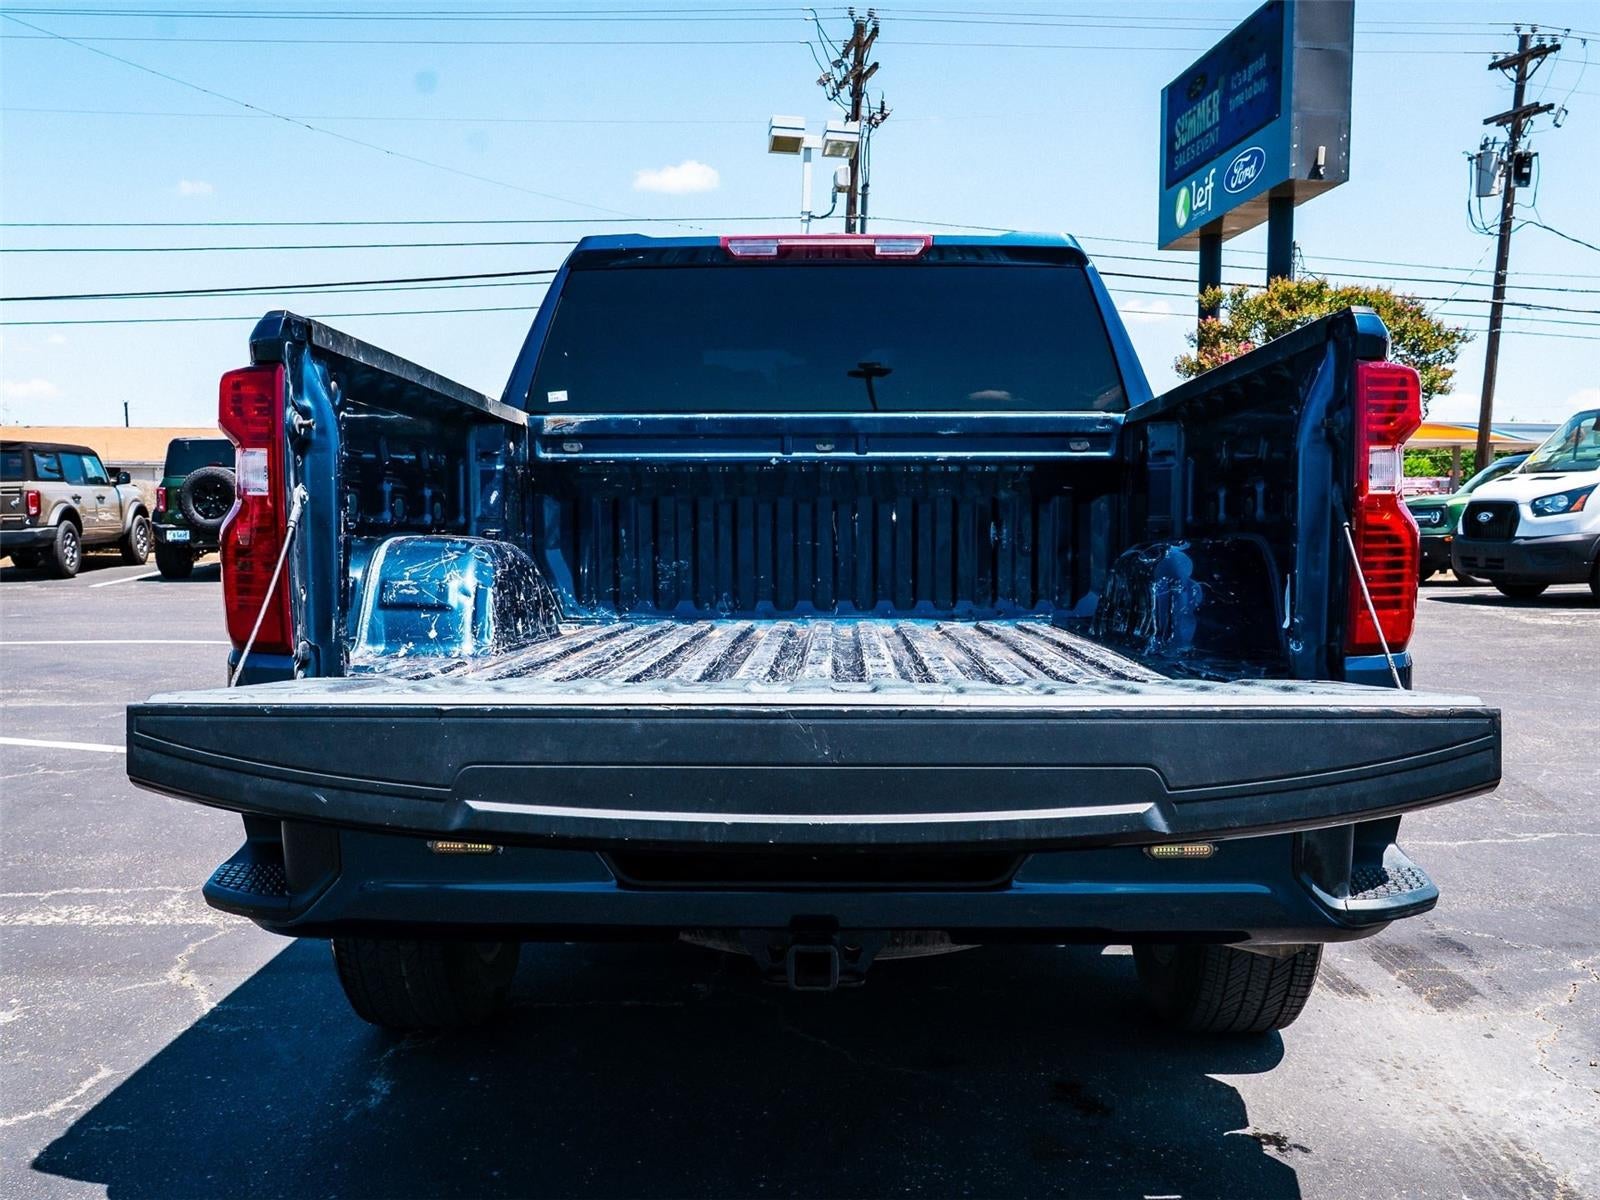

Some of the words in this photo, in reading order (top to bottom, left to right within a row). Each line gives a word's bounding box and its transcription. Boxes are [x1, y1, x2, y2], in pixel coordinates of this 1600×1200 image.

[1174, 89, 1220, 151] SUMMER
[1174, 144, 1196, 170] SALES
[1196, 127, 1220, 156] EVENT
[1231, 154, 1257, 188] Ford
